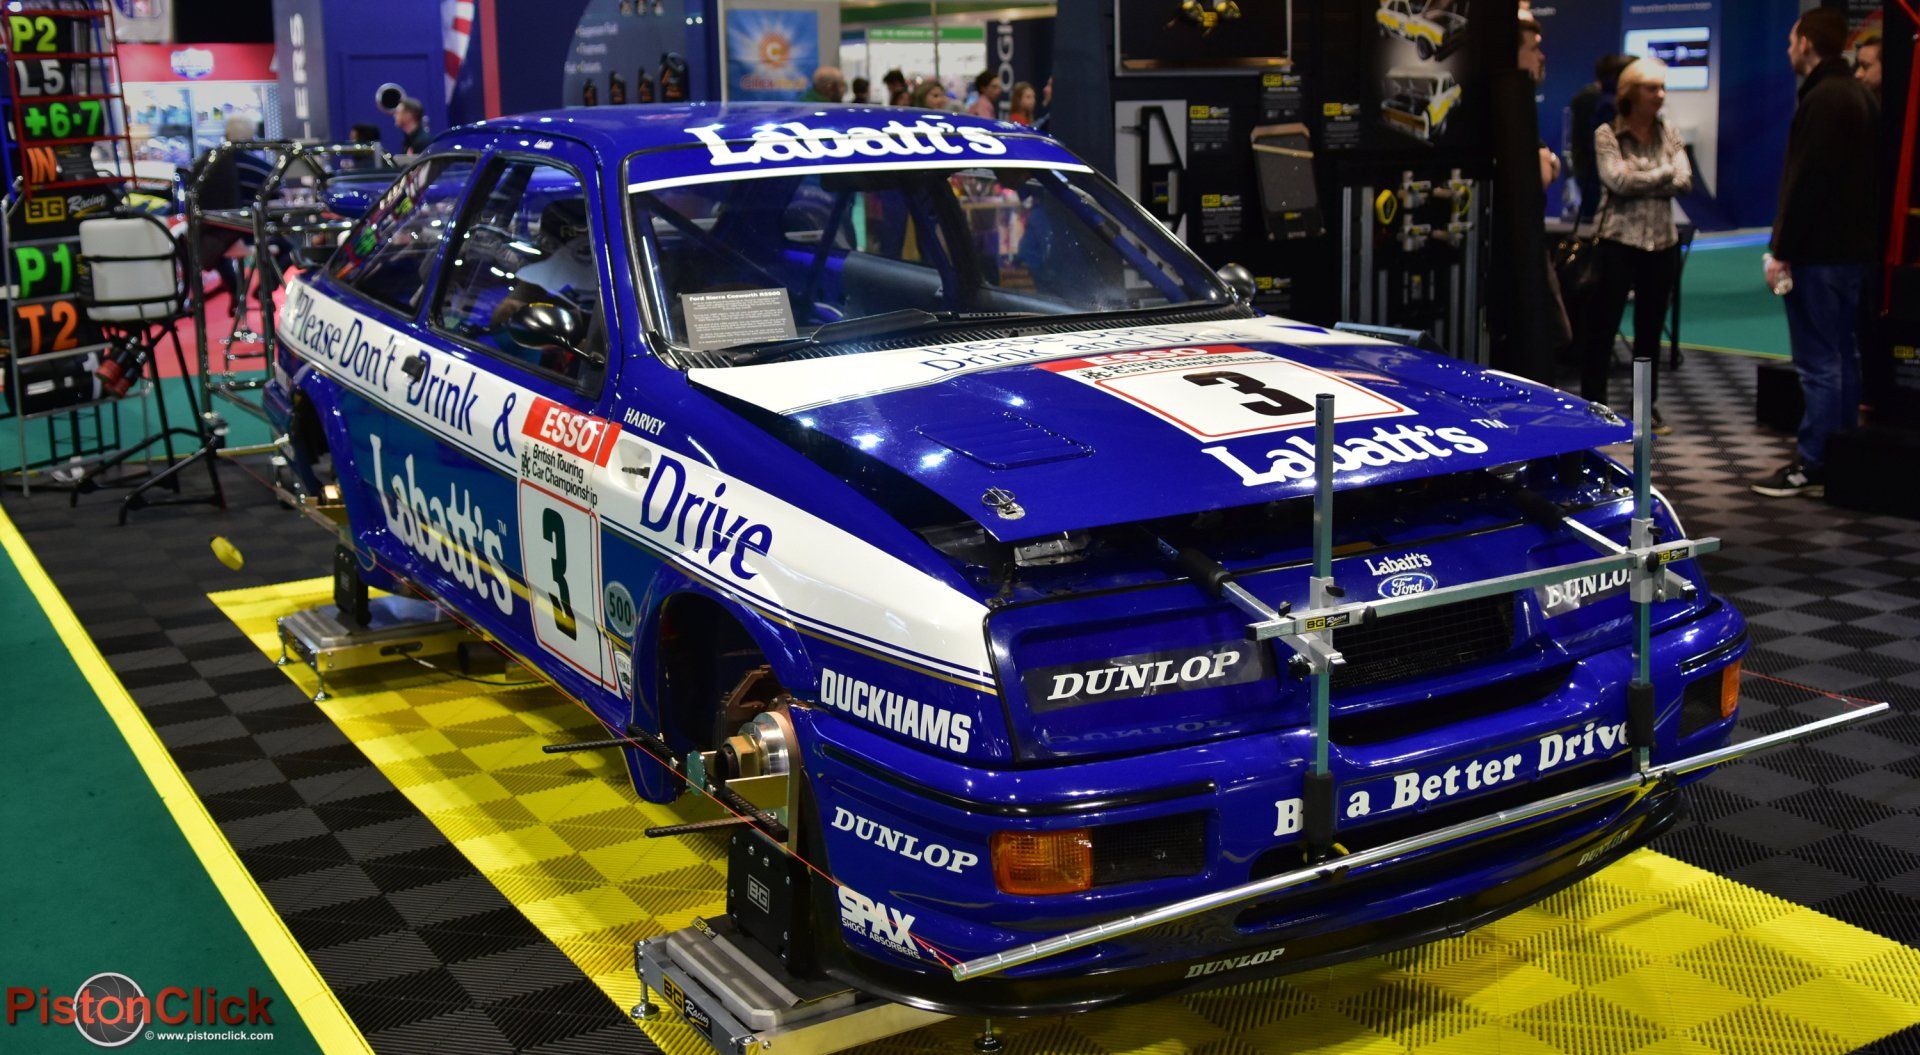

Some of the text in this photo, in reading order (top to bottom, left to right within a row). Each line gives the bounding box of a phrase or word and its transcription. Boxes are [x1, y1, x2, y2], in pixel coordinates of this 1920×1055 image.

[9, 15, 57, 52] P2
[15, 59, 65, 97] L5
[684, 119, 1007, 166] Labatt's
[29, 199, 64, 220] BG
[15, 243, 73, 299] P1
[17, 301, 79, 356] T2
[920, 348, 1052, 372] Drink
[1066, 337, 1150, 351] and
[1085, 347, 1209, 366] ESSO
[1103, 354, 1234, 371] British Touring
[1115, 356, 1276, 375] Car Championship
[1182, 371, 1316, 417] 3
[540, 406, 598, 454] ESSO
[623, 406, 666, 437] HARVEY
[339, 317, 396, 393] Don't
[406, 351, 479, 437] Drink
[492, 391, 519, 460] &
[639, 454, 773, 581] Drive
[532, 443, 584, 484] British Touring
[1201, 424, 1489, 487] Labatt's
[531, 461, 598, 508] Car Championship
[370, 433, 513, 616] Labatt's
[542, 507, 577, 642] 3
[1364, 552, 1433, 576] Labatt's
[609, 590, 632, 626] 500
[1391, 577, 1425, 597] Ford
[1546, 568, 1632, 609] DUNLO
[1306, 618, 1325, 629] BG
[1047, 650, 1240, 701] DUNLOP
[820, 667, 973, 755] DUCKHAMS
[1273, 797, 1304, 837] B
[1346, 789, 1371, 819] a
[1391, 751, 1522, 811] Better
[830, 806, 979, 875] DUNLOP
[748, 878, 769, 909] BG
[838, 885, 919, 952] SPAX
[841, 916, 921, 960] SHOCK ABSORBERS
[1185, 947, 1286, 980] DUNLOP
[663, 976, 709, 1028] BG Racing
